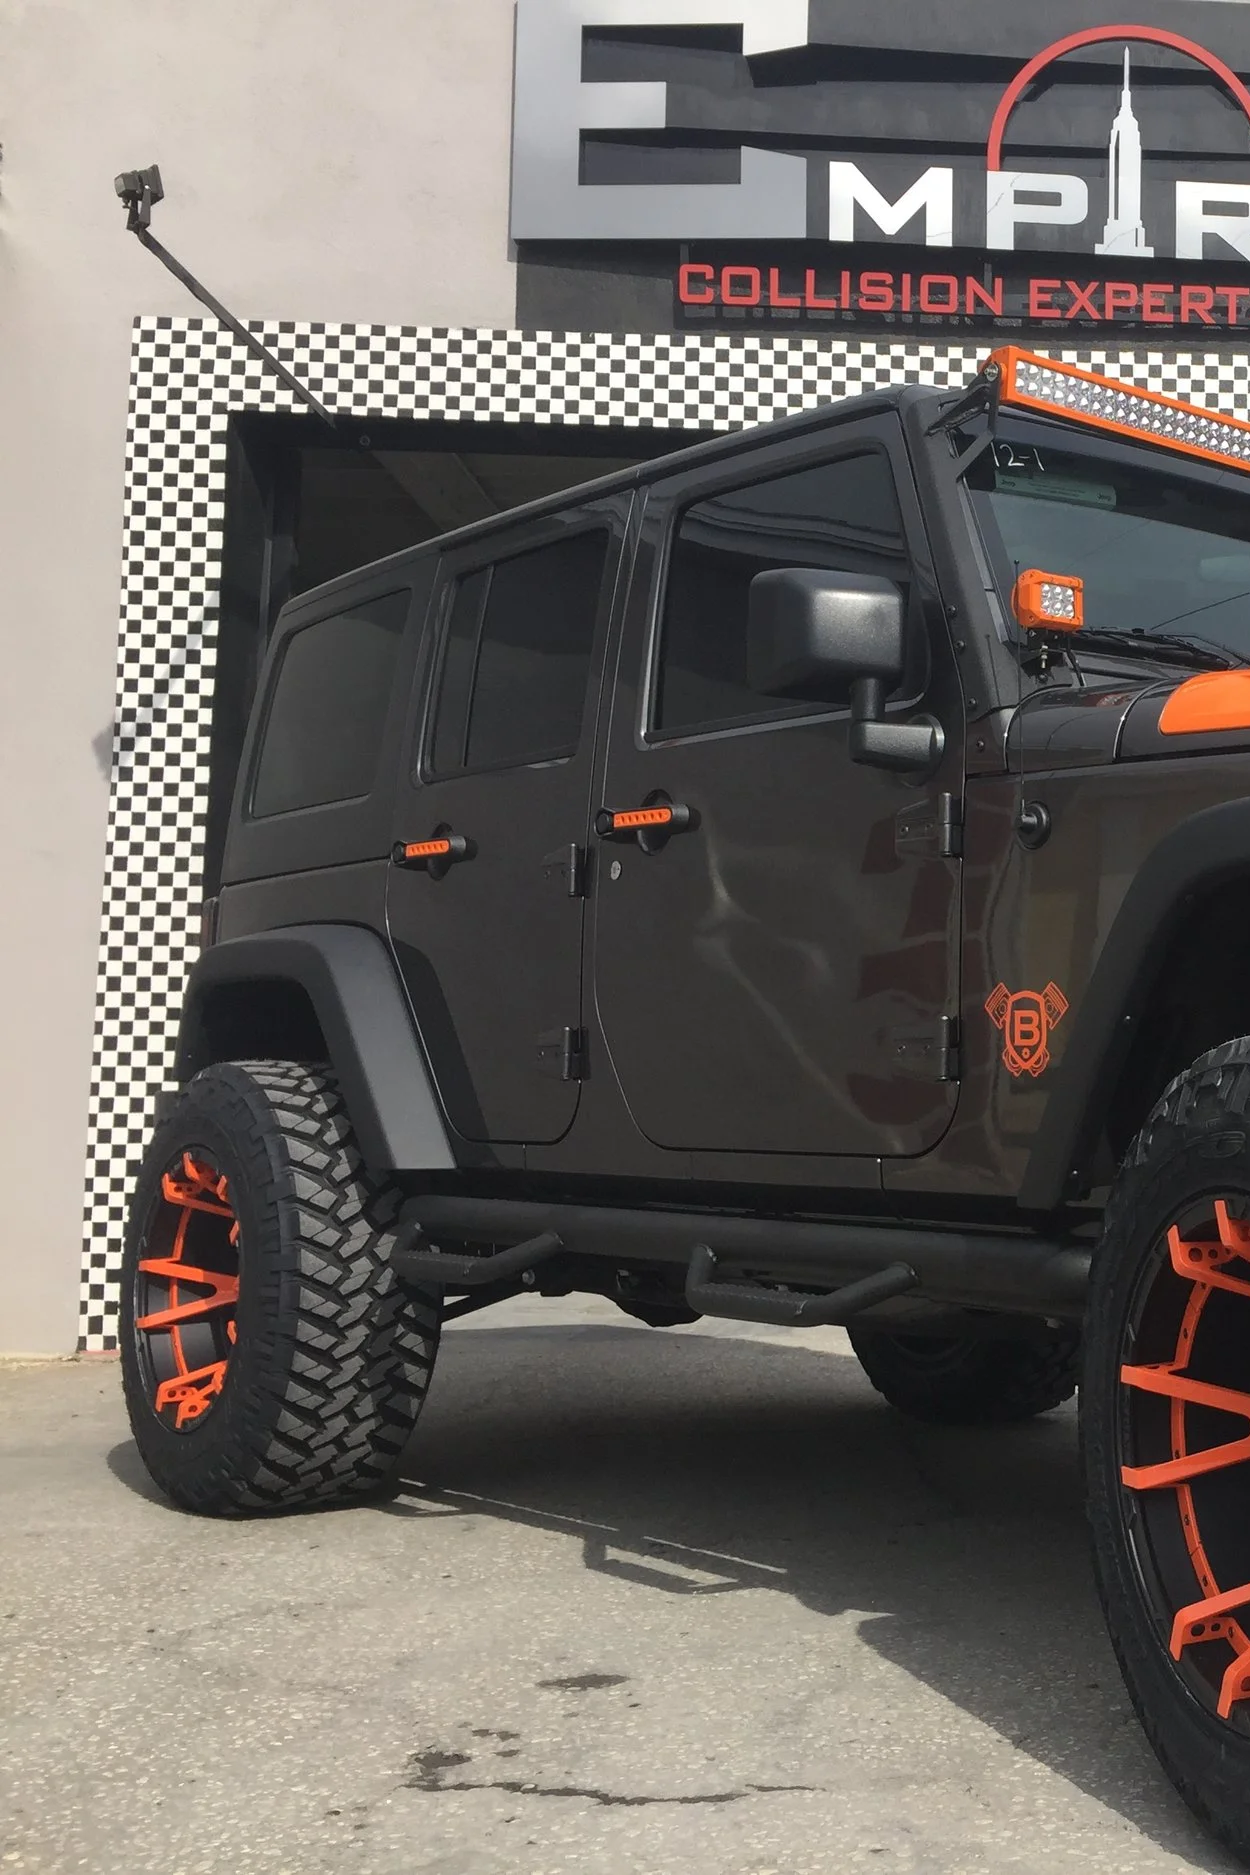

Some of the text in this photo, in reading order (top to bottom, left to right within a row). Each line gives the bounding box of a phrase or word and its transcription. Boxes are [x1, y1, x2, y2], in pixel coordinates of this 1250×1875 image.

[678, 264, 1004, 316] COLLISION
[990, 442, 1045, 471] 12-1
[1013, 1010, 1041, 1046] B
